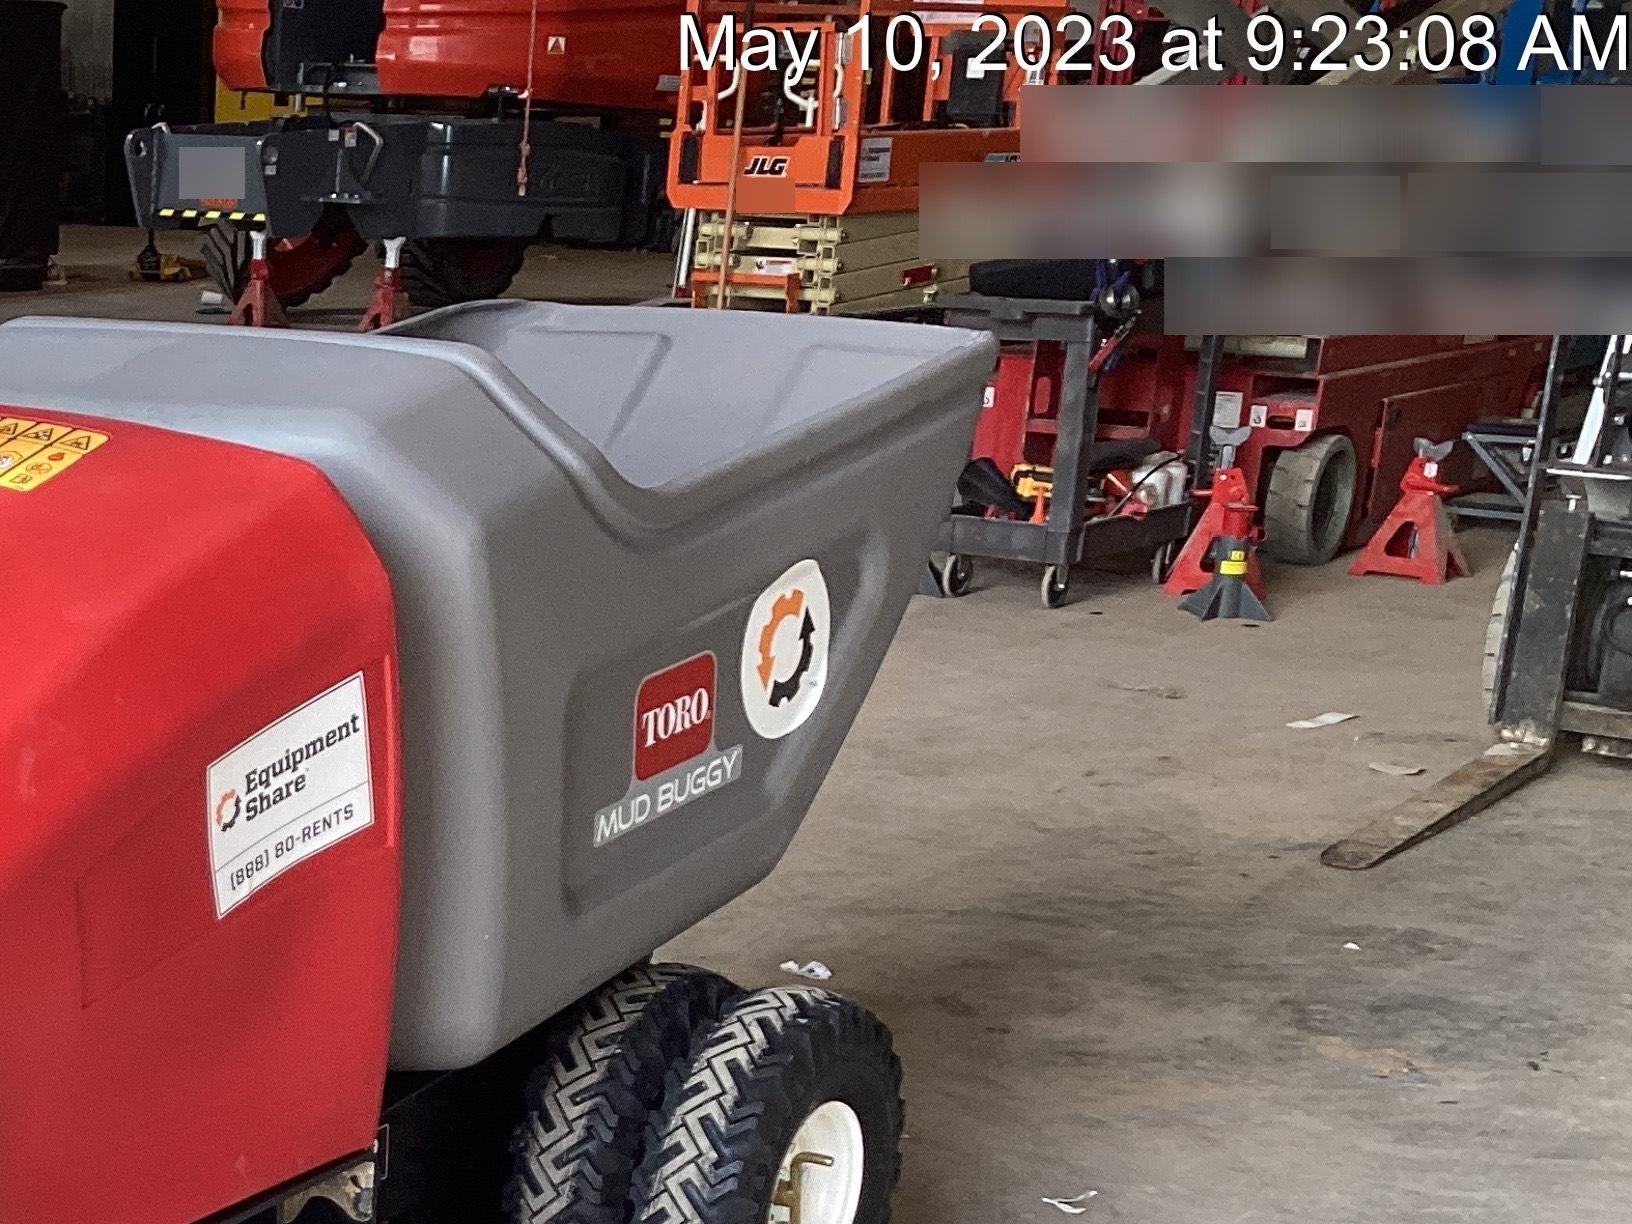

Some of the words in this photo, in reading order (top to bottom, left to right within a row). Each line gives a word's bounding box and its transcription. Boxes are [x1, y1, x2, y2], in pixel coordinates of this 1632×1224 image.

[743, 156, 788, 176] JLG
[244, 712, 361, 796] Equipment
[641, 687, 709, 749] TORO
[245, 773, 306, 822] Share
[596, 793, 652, 843] MUD
[656, 750, 739, 813] BUGGY
[230, 848, 270, 891] (888)
[274, 803, 355, 860] 80-RENTS
